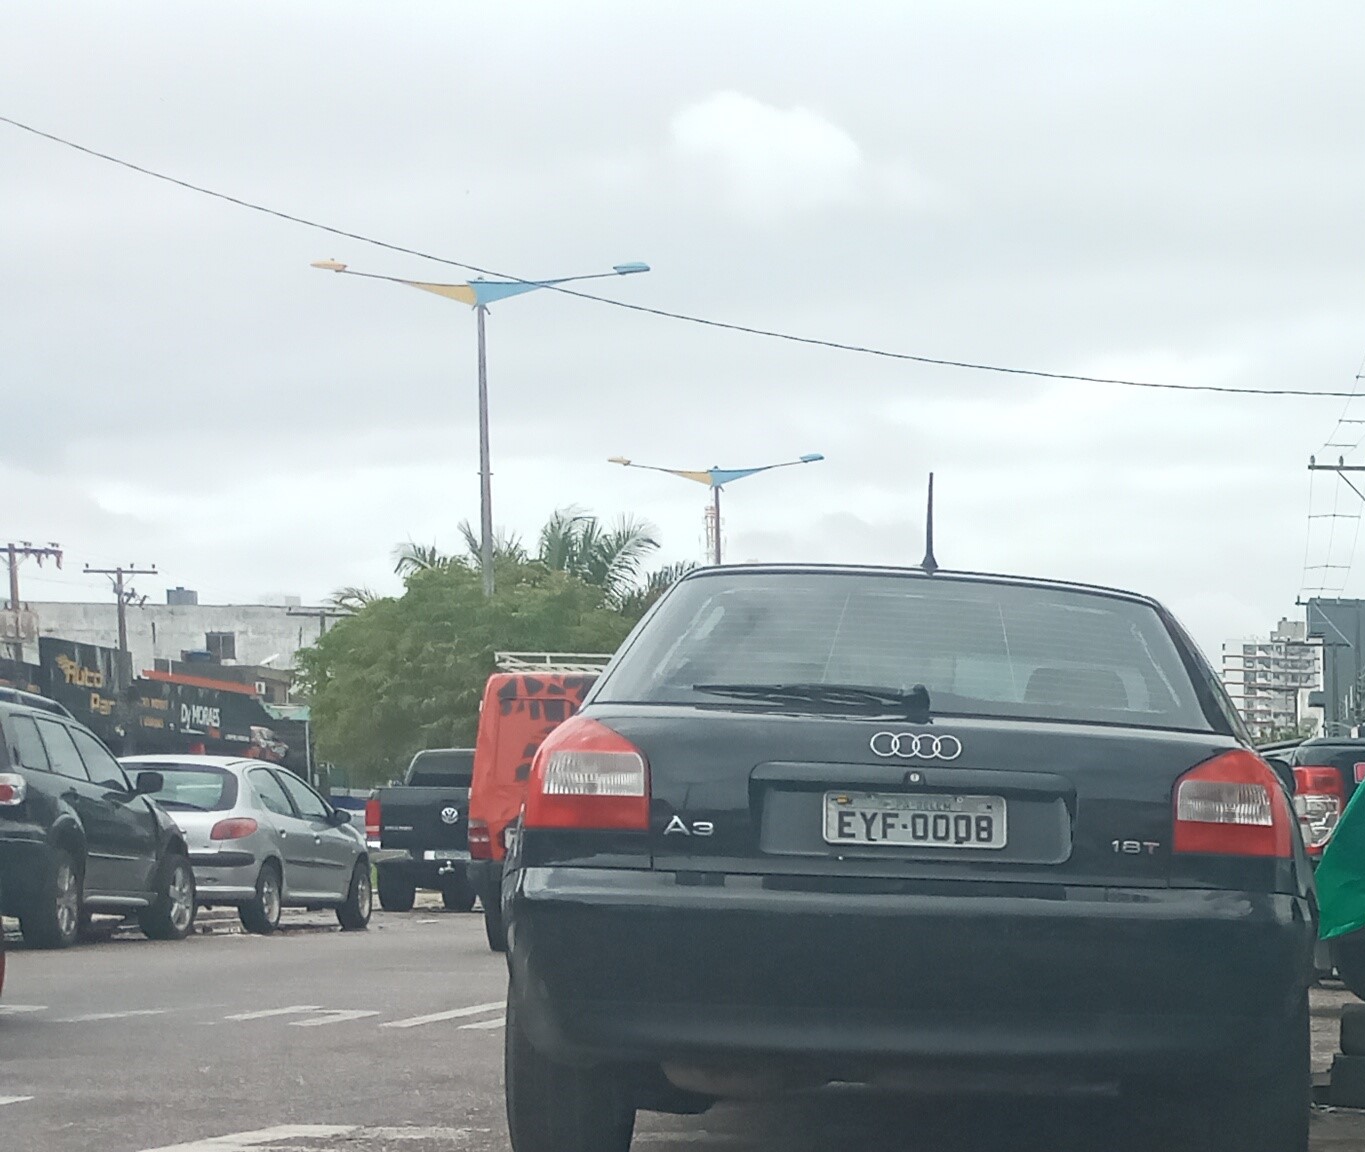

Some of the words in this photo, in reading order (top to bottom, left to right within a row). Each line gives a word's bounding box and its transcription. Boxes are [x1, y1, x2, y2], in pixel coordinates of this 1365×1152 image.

[191, 705, 221, 728] MORAES
[663, 815, 714, 836] A3
[837, 810, 994, 844] EYF-0008
